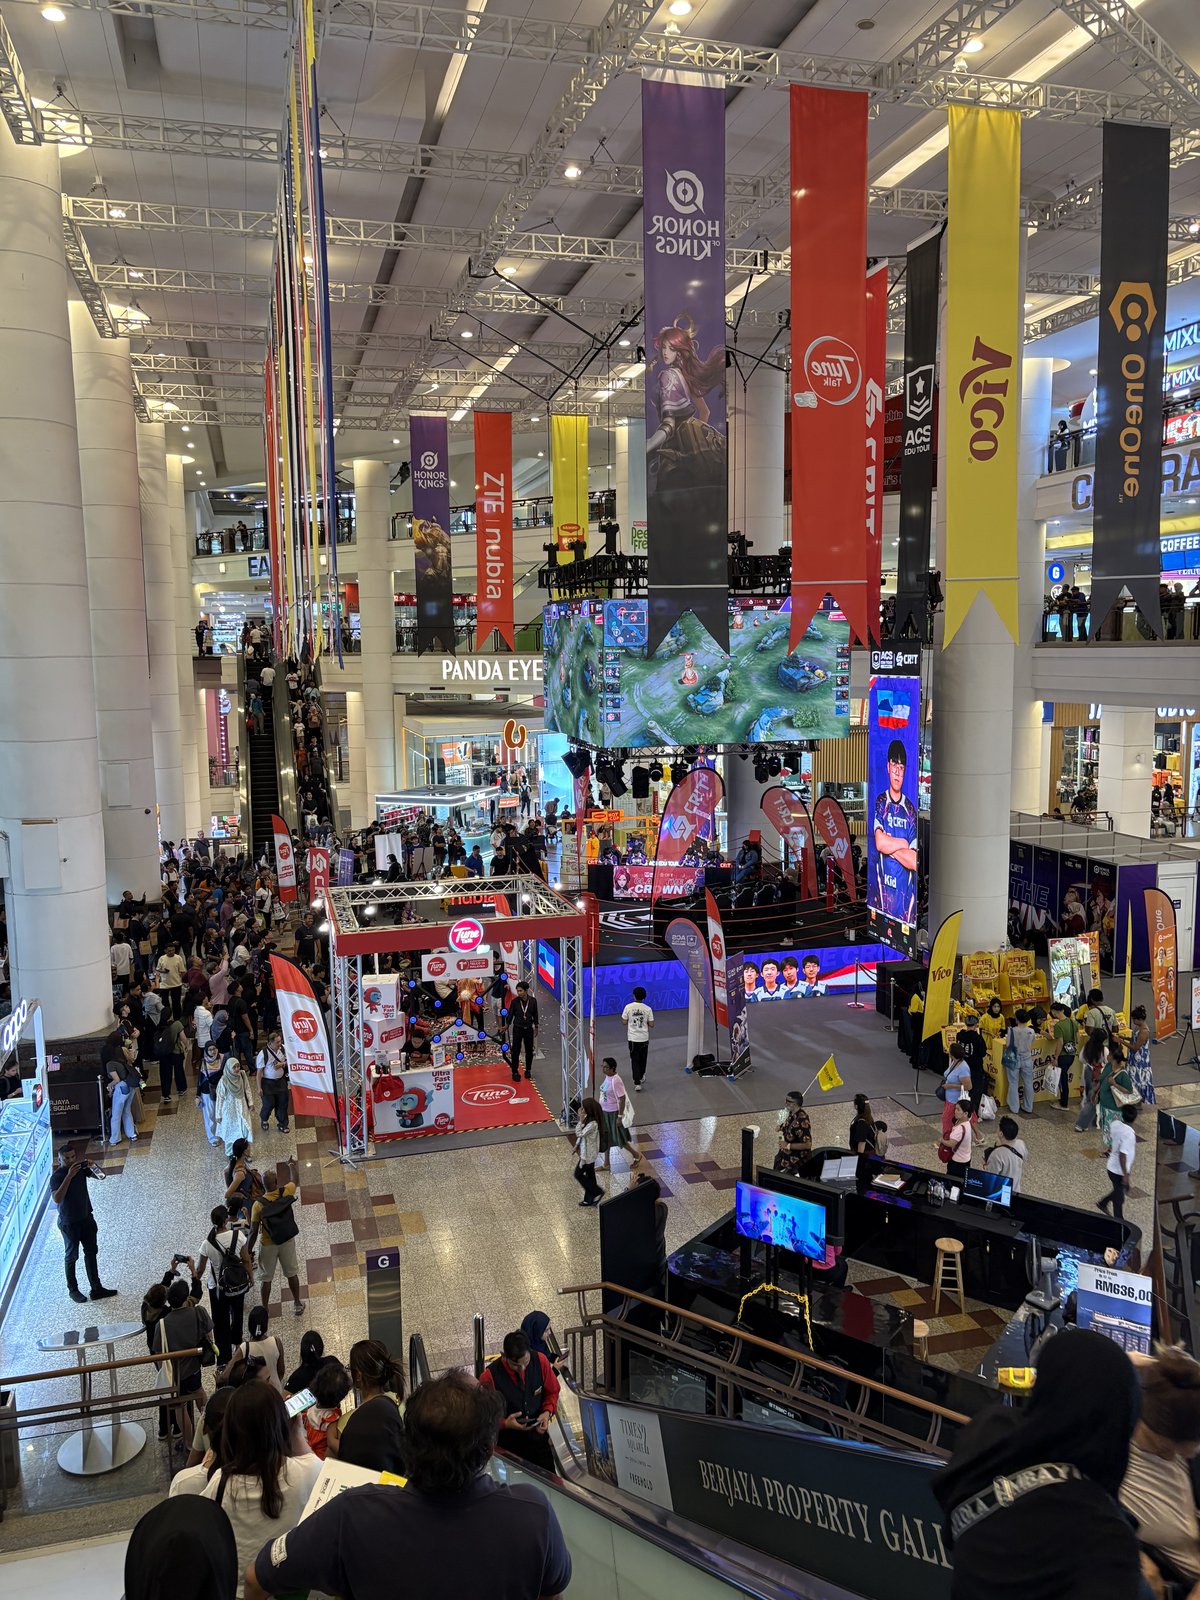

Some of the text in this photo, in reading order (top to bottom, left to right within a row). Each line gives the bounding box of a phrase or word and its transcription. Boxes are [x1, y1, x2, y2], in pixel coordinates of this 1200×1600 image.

[904, 424, 932, 447] ACS
[414, 470, 448, 482] HONOR
[418, 479, 445, 489] KINGS
[483, 471, 505, 599] ZTE nubia
[442, 659, 504, 681] PANDA
[884, 873, 897, 889] Kid
[453, 927, 480, 944] Tune
[931, 965, 952, 983] Vico
[3, 999, 28, 1052] oppo
[431, 1070, 450, 1078] Ultra
[468, 1089, 510, 1101] Tune
[377, 1255, 390, 1268] G
[619, 1418, 643, 1440] TIMES
[629, 1472, 653, 1491] FREEHOLD
[698, 1460, 763, 1508] BERJAYA
[762, 1477, 873, 1544] PROPERTY
